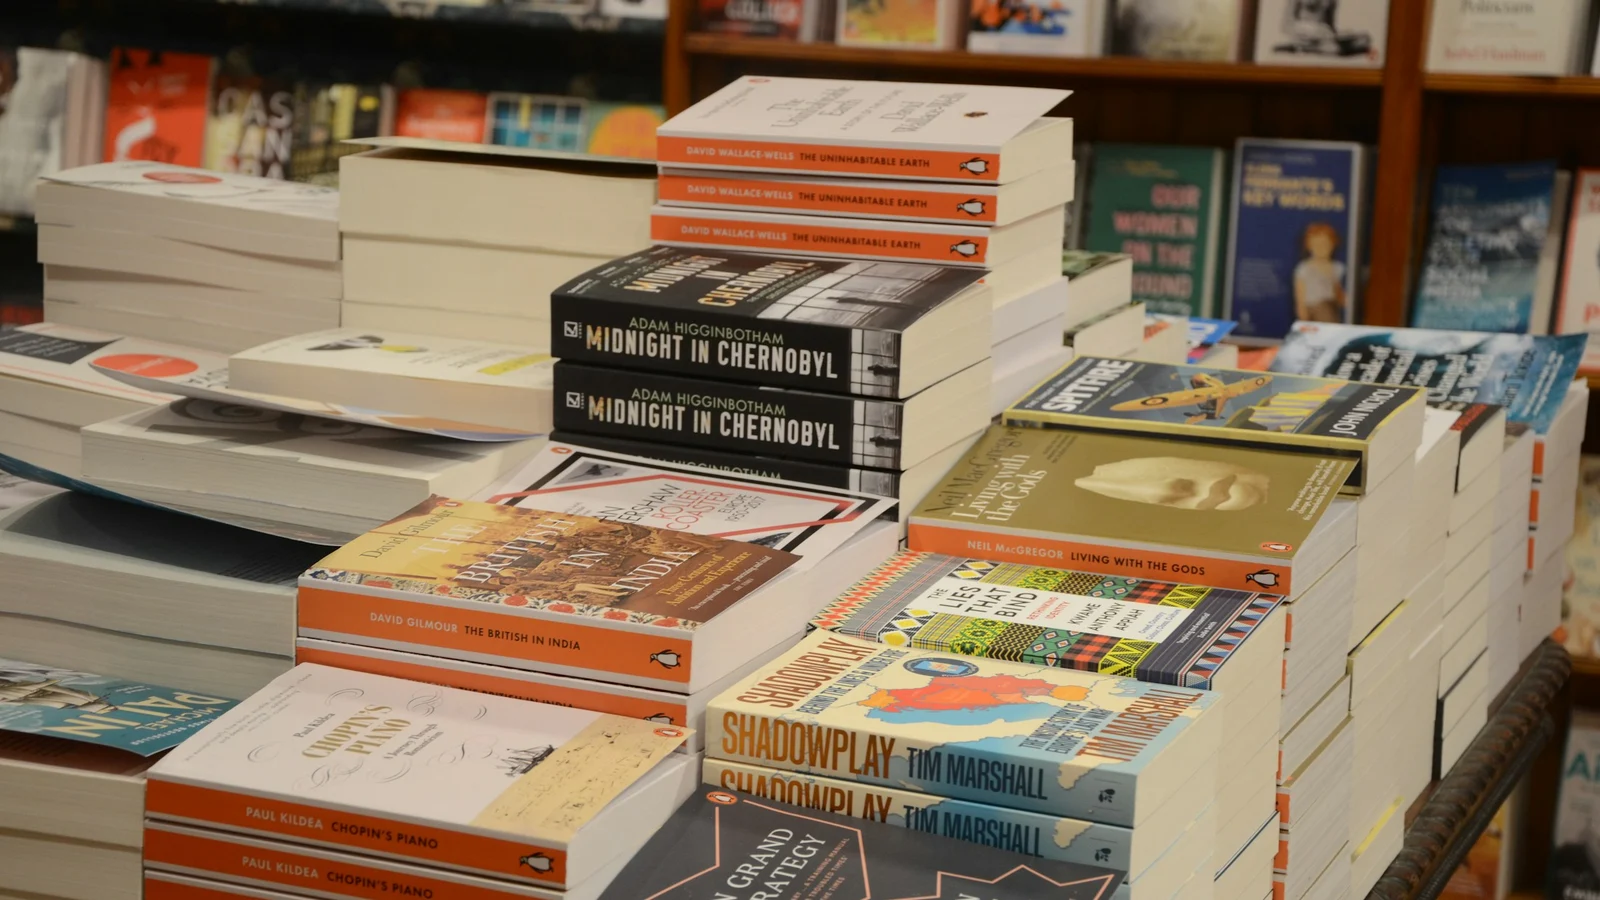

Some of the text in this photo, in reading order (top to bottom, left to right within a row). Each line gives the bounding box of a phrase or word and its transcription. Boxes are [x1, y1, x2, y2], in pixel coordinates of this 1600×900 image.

[686, 146, 930, 168] DAVID WALLACE-WELLS THE UNINHABITABLE EARTH
[687, 184, 928, 208] DAVID WALLACE-WELLS THE UNINHABITABLE EARTH
[681, 225, 921, 250] DAVID WALLACE-WELLS THE UNINHABITABLE EARTH
[624, 255, 728, 293] MIDNIGHT
[696, 270, 739, 280] IN
[698, 261, 815, 307] CHERNOBYL
[1132, 272, 1193, 298] OUND
[629, 317, 784, 345] ADAM HIGGINBOTHAM
[586, 325, 683, 360] MIDNIGHT
[691, 339, 709, 364] IN
[718, 341, 838, 379] CHERNOBYL
[631, 388, 786, 416] ADAM HIGGINBOTHAM
[1041, 359, 1135, 412] SPITFIRE
[588, 395, 686, 431] MIDNIGHT
[693, 410, 711, 434] IN
[720, 411, 840, 450] CHERNOBYL
[1329, 388, 1400, 436] JOHN NICHOL
[924, 427, 1023, 512] Neil MacGregor
[951, 454, 1031, 519] Living with
[594, 506, 624, 522] AN
[617, 484, 681, 524] ERSHAW
[666, 491, 734, 531] COASTER
[718, 493, 748, 513] EUROPE
[984, 469, 1048, 521] the Gods
[359, 509, 454, 559] David Gilmour
[412, 523, 488, 556] THE
[453, 517, 578, 585] BRITISH
[560, 548, 610, 569] IN
[609, 549, 698, 593] INDIA
[967, 540, 992, 552] NEIL
[1070, 552, 1110, 565] LIVING
[1114, 556, 1144, 569] WITH
[1147, 561, 1168, 571] THE
[1171, 563, 1206, 576] GODS
[927, 588, 948, 599] THE
[939, 586, 982, 609] LIES
[964, 587, 1011, 613] THAT
[994, 592, 1038, 618] BIND
[370, 612, 581, 650] DAVID GILMOUR THE BRITISH IN INDIA
[1068, 603, 1102, 626] KWAME
[1087, 602, 1126, 632] ANTHONY
[1113, 608, 1146, 631] APPIAH
[736, 637, 877, 708] SHADOWPLAY
[820, 686, 852, 696] THE
[42, 691, 230, 738] PALIN
[135, 706, 222, 731] MICHAEL
[293, 713, 335, 738] Paul Kildea
[302, 704, 392, 758] CHOPIN'S
[1075, 688, 1204, 762] TIM MARSHALL
[344, 718, 411, 755] PIANO
[1018, 738, 1048, 749] THE
[722, 711, 1048, 801] SHADOWPLAY TIM MARSHALL
[245, 806, 439, 849] PAUL KILDEA CHOPIN'S PIANO
[720, 769, 1044, 858] SHADOWPLAY TIM MARSHALL
[726, 827, 794, 889] GRAND
[751, 834, 826, 900] RATEGY
[242, 856, 433, 899] PAUL KILDEA CHOPIN'S PIANO
